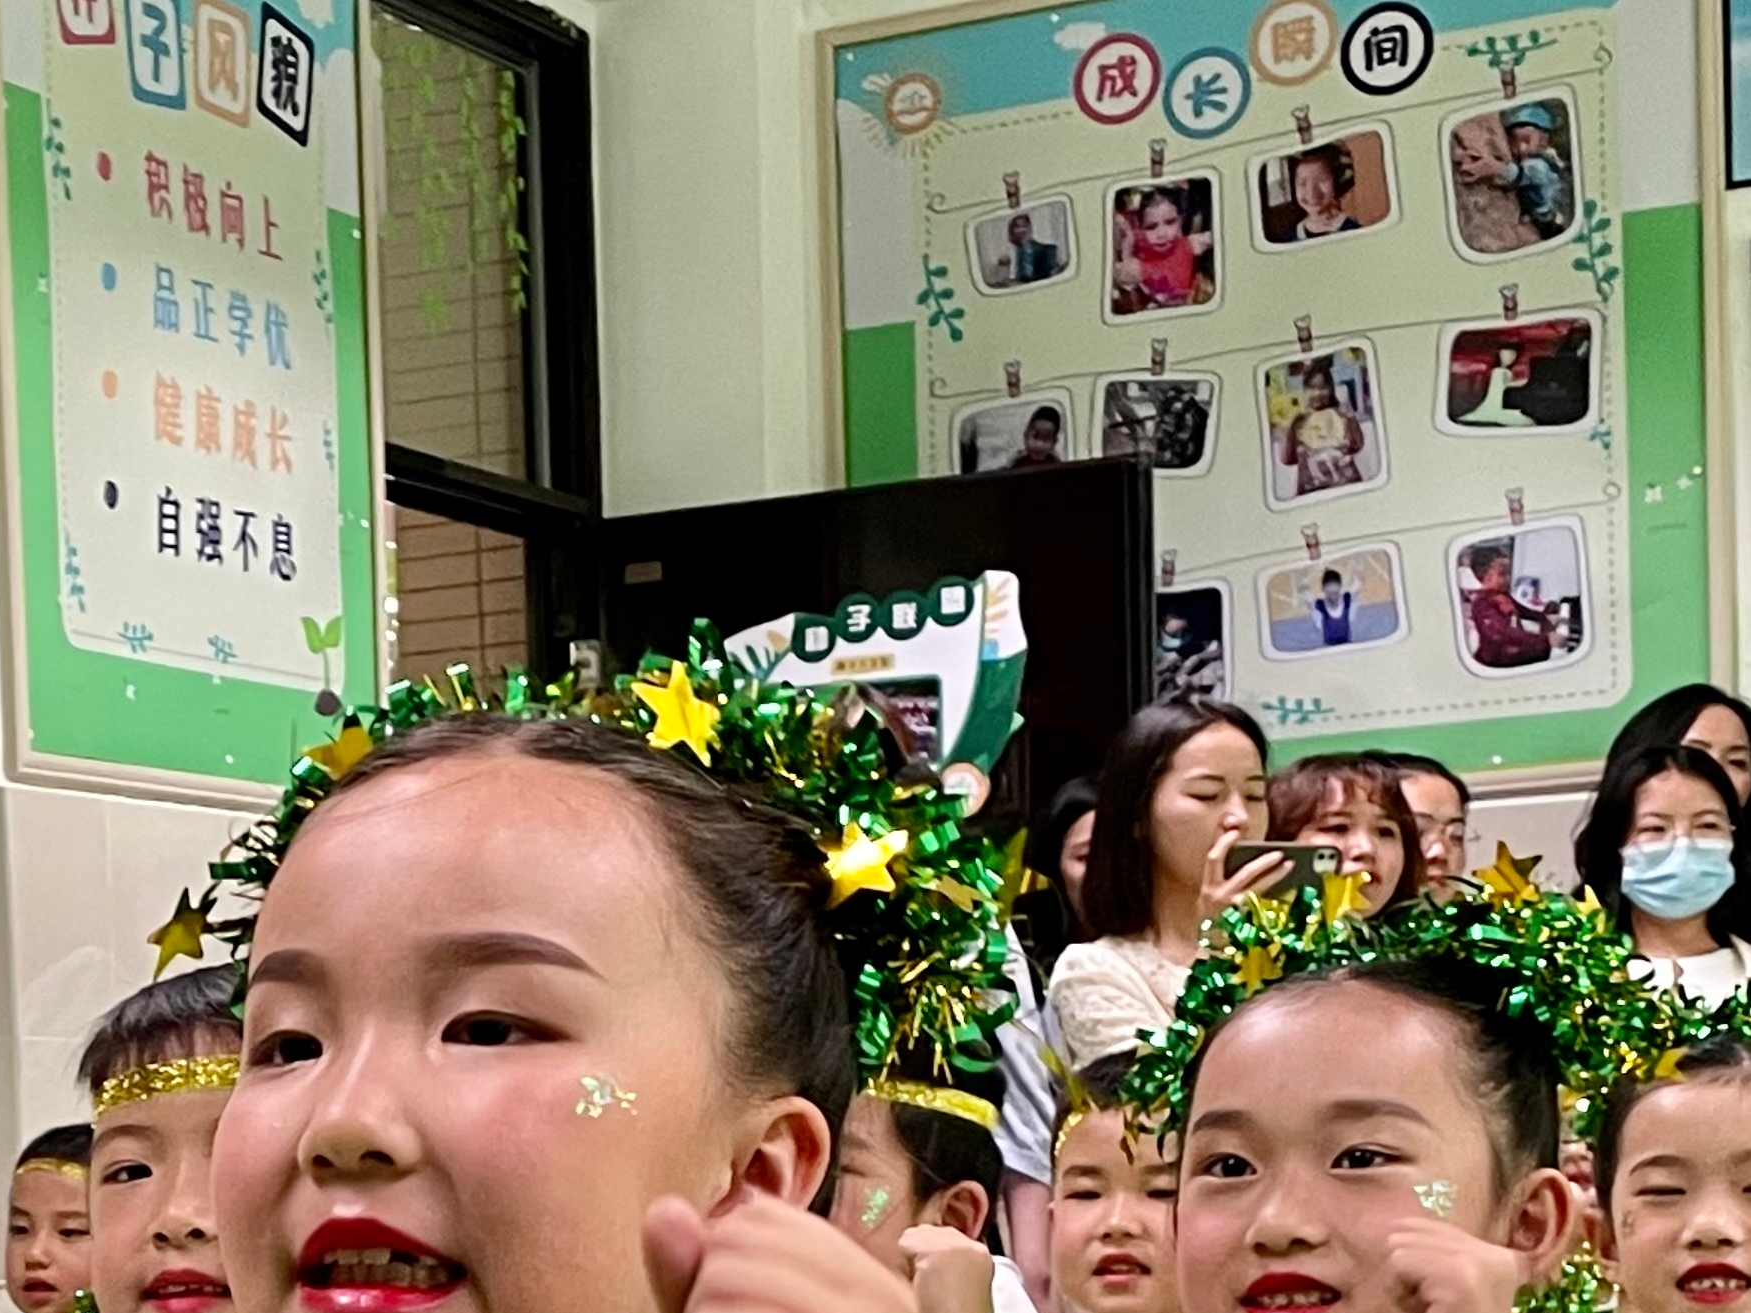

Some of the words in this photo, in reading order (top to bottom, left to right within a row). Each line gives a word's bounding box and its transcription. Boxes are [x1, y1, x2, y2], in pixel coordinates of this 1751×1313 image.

[72, 0, 300, 118] 子风貌
[1095, 14, 1411, 119] 成长瞬间
[144, 150, 283, 261] 积极向上
[153, 266, 292, 370] 品正学优
[153, 370, 293, 475] 健康成长
[157, 485, 298, 582] 自强不息
